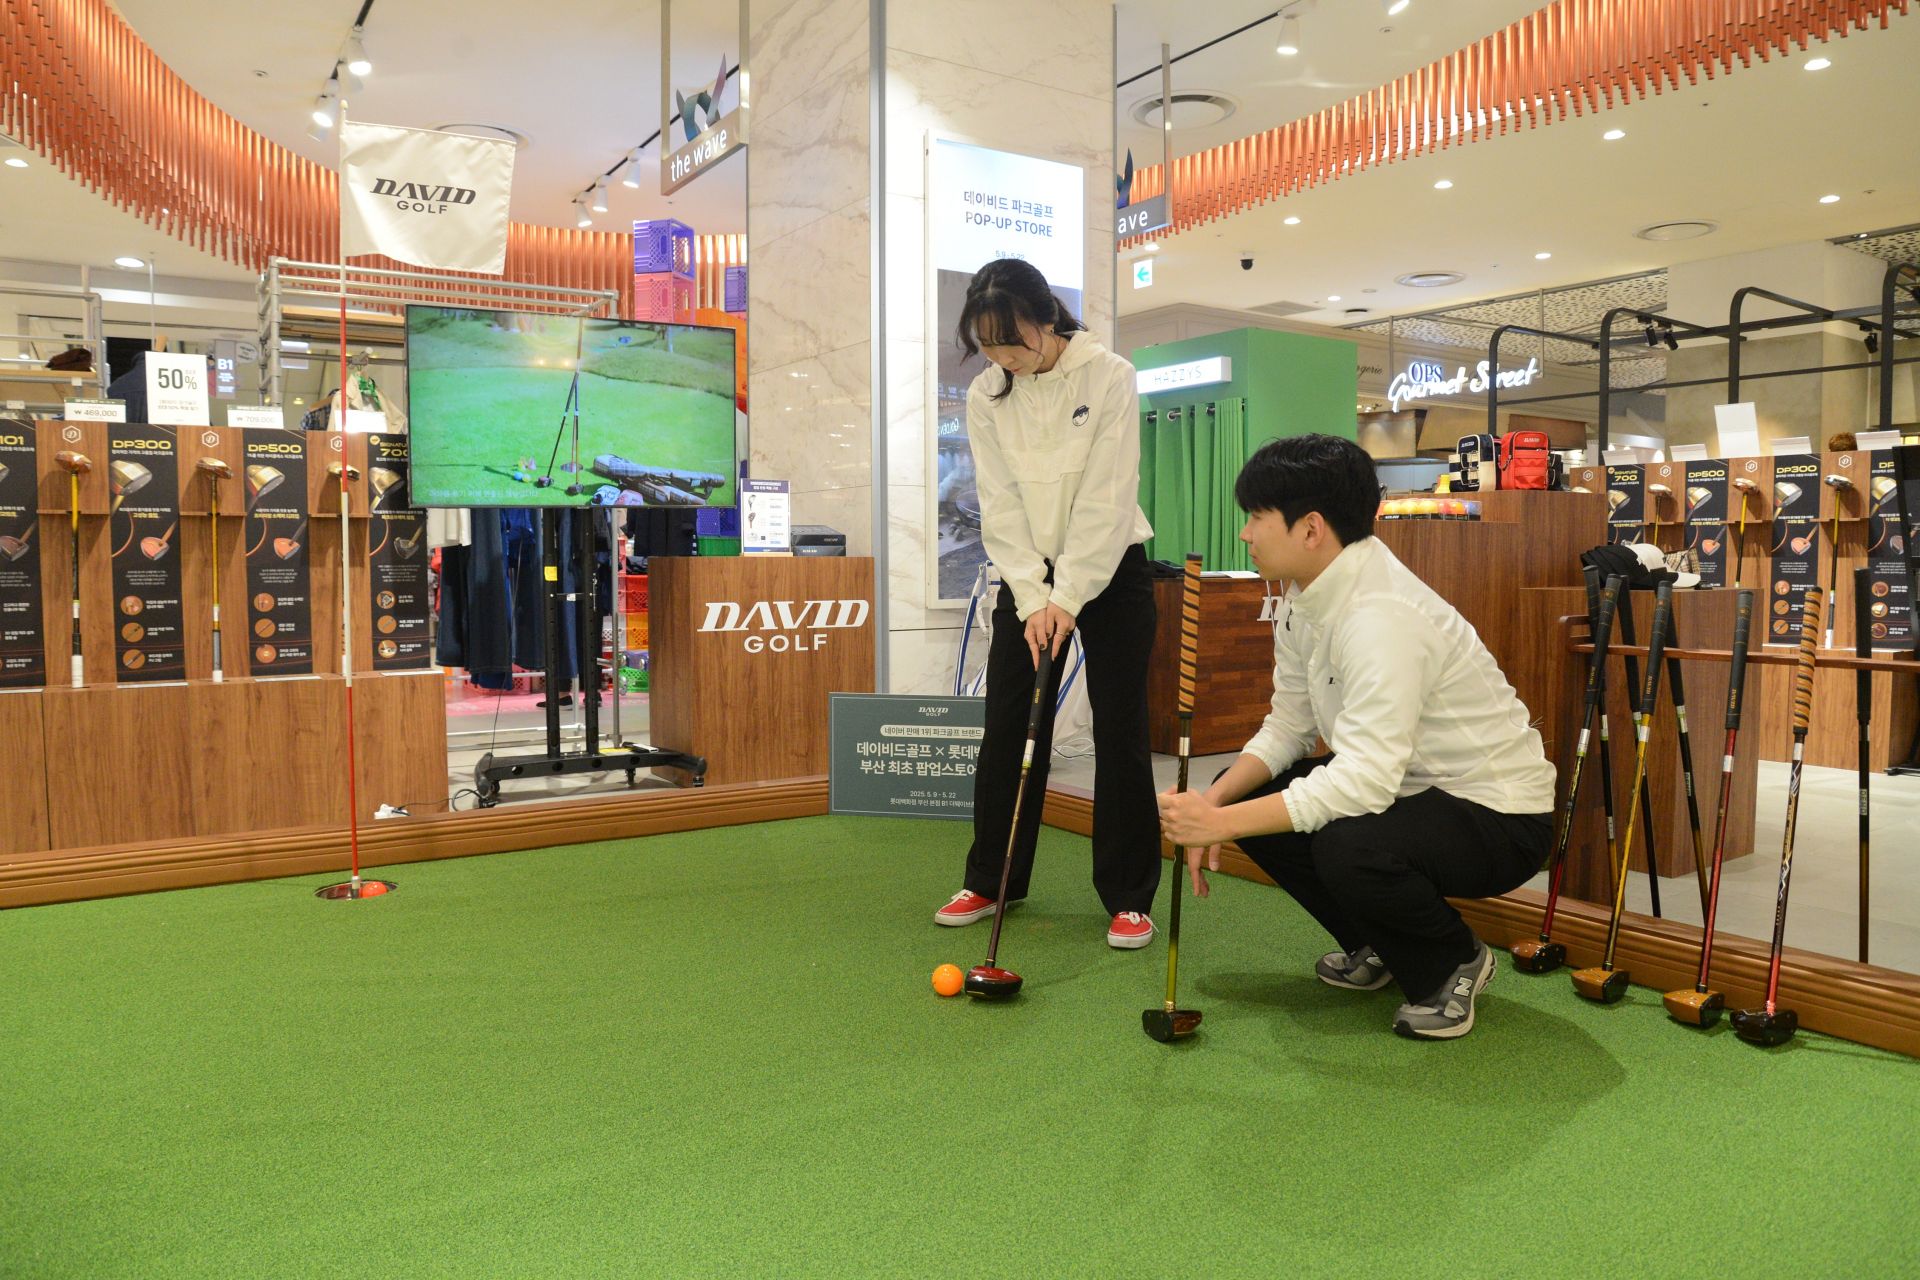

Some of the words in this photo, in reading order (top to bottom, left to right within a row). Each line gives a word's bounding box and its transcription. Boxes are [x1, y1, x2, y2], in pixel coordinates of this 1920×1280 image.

[670, 153, 691, 182] the
[693, 129, 727, 167] wave
[369, 178, 476, 205] DAVID
[396, 200, 448, 214] GOLF
[963, 190, 1009, 210] 데이비드
[1011, 199, 1054, 219] 파크골프
[965, 211, 1012, 230] POP-UP
[1015, 219, 1053, 238] STORE
[1117, 210, 1148, 234] ave
[217, 358, 234, 370] B1
[1409, 361, 1444, 384] OPS
[1154, 365, 1202, 385] HAZZYS
[1387, 366, 1469, 413] Gourmet
[112, 439, 172, 450] DP300
[248, 443, 302, 453] DP500
[1688, 469, 1726, 479] DP500
[1776, 464, 1818, 474] DP300
[1614, 474, 1638, 482] 700
[697, 599, 870, 632] DAVID
[744, 633, 828, 654] GOLF
[918, 706, 949, 714] DAVID
[884, 727, 905, 736] 네이버
[906, 728, 920, 736] 판매
[921, 728, 932, 737] 1위
[932, 729, 960, 738] 파크골프
[961, 729, 982, 738] 브랜드
[856, 742, 932, 759] 데이비드골프
[860, 760, 886, 775] 부산
[887, 761, 914, 776] 최초
